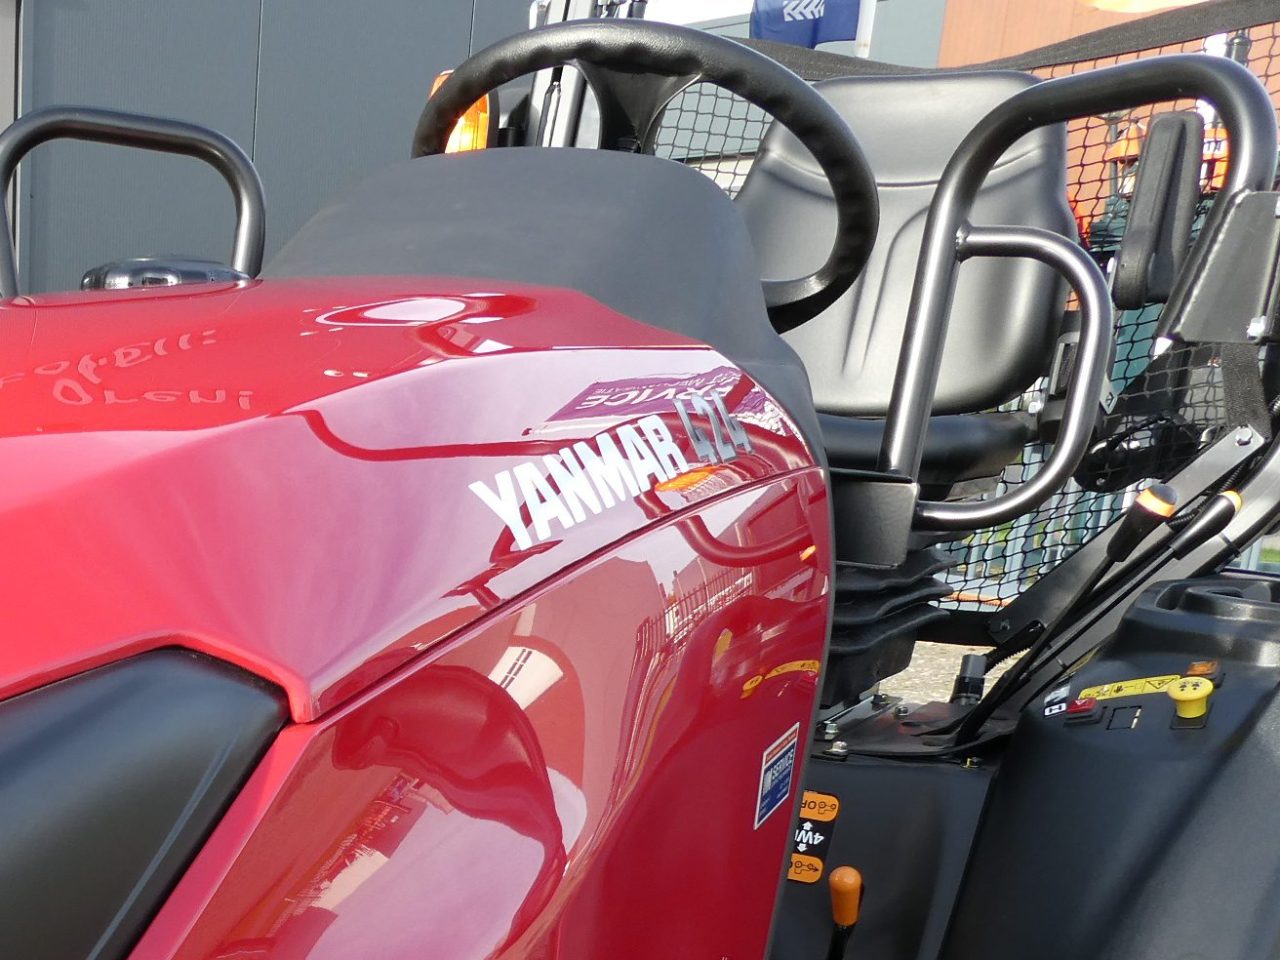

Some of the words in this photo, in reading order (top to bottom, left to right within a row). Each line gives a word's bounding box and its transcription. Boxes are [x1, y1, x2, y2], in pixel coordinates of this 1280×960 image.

[469, 415, 688, 551] YANMAR
[673, 390, 754, 465] 424
[794, 829, 825, 845] 4W
